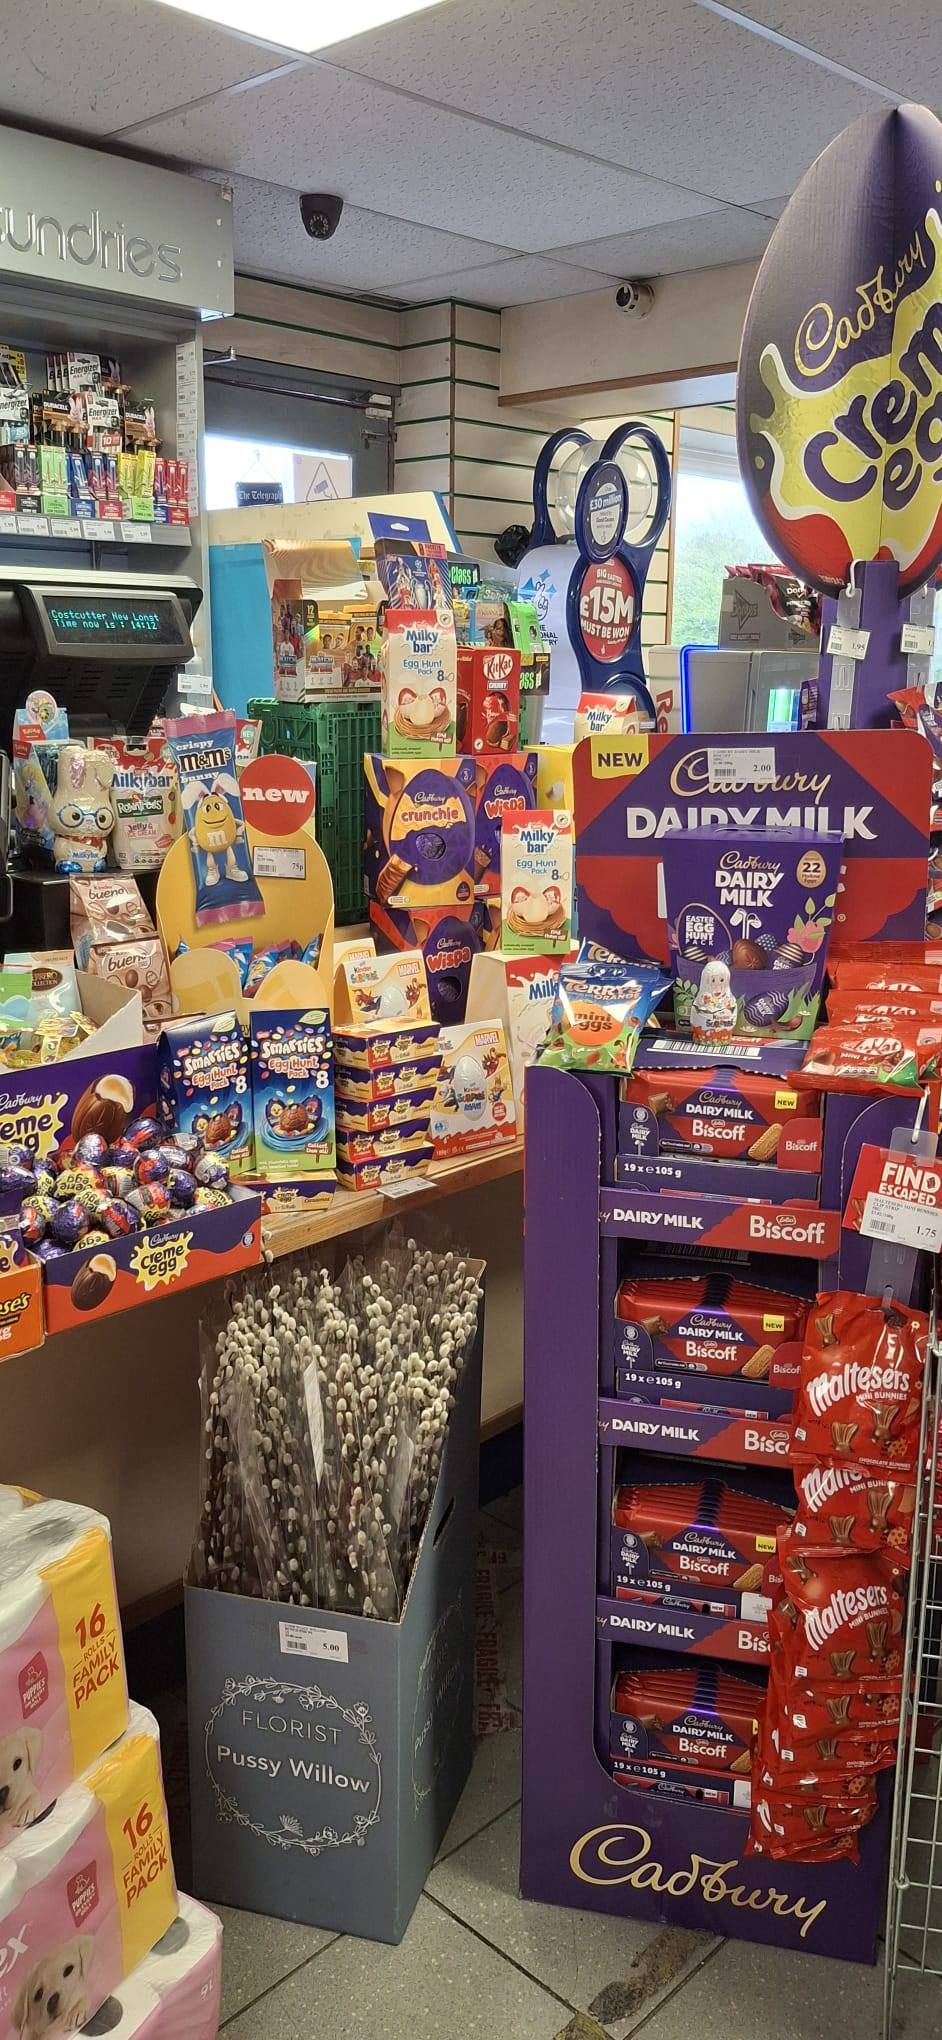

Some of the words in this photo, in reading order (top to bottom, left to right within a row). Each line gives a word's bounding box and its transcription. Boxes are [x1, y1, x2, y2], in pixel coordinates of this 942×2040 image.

[0, 207, 183, 283] undries
[794, 232, 927, 376] Cadbury
[70, 363, 100, 375] Energizer
[0, 399, 27, 410] nergizer
[803, 302, 942, 502] crem
[88, 408, 117, 418] Energizer
[597, 569, 607, 578] BIG
[580, 586, 633, 624] £15M
[51, 610, 107, 620] Costcutter
[54, 619, 78, 628] Time
[131, 621, 157, 630] 14:12
[581, 621, 600, 636] MUST
[601, 625, 611, 638] BE
[612, 626, 630, 639] WON
[405, 630, 439, 645] Milky
[413, 641, 433, 653] bar
[403, 660, 419, 669] Egg
[421, 660, 442, 669] Hunt
[485, 654, 513, 679] KitKat
[437, 670, 444, 682] 8
[587, 711, 612, 723] Milky
[590, 722, 605, 732] bar
[176, 739, 214, 752] crispy
[597, 752, 643, 768] NEW
[753, 764, 771, 772] 2.00
[181, 771, 220, 784] bunny
[243, 787, 310, 804] new
[415, 792, 445, 804] Cadbury
[494, 785, 517, 796] Cadbury
[401, 807, 459, 823] crunchie
[520, 830, 554, 843] Milky
[527, 841, 548, 853] bar
[292, 862, 304, 871] 75p
[517, 860, 532, 869] Egg
[536, 859, 557, 867] Hunt
[719, 850, 781, 874] Cadbury
[802, 862, 821, 873] 22
[551, 869, 559, 880] 8
[715, 871, 784, 890] DAIRY
[89, 886, 124, 900] bueno
[720, 888, 774, 908] MILK
[685, 915, 714, 924] EASTER
[685, 923, 715, 933] EGG
[685, 931, 715, 940] HUNT
[685, 938, 714, 946] PACK
[426, 948, 471, 972] Wispa
[397, 962, 421, 976] MARVEL
[529, 978, 558, 1000] Milk
[576, 1020, 612, 1031] ggs
[474, 1031, 499, 1046] MARVEL
[262, 1037, 324, 1059] SMARTIES
[184, 1043, 240, 1075] SMARTIES
[268, 1059, 288, 1072] Egg
[292, 1056, 319, 1070] Hunt
[192, 1075, 211, 1088] Egg
[212, 1063, 237, 1080] Hunt
[288, 1069, 308, 1078] Pack
[316, 1071, 329, 1088] 8
[210, 1080, 229, 1090] Pack
[235, 1075, 247, 1094] 8
[699, 1091, 742, 1108] Cadbury
[777, 1099, 794, 1107] NEW
[686, 1103, 723, 1117] DAIRY
[724, 1108, 754, 1121] MILK
[0, 1114, 53, 1140] eme
[630, 1128, 650, 1137] DAIRY
[692, 1119, 745, 1141] Biscoff
[785, 1140, 817, 1152] Biscoff
[624, 1163, 636, 1172] 19
[655, 1165, 673, 1175] 105
[675, 1169, 681, 1178] g
[881, 1162, 942, 1193] FIND
[878, 1183, 936, 1206] ESCAPED
[613, 1208, 662, 1225] DAIRY
[663, 1213, 704, 1230] MILK
[749, 1215, 825, 1245] Biscoff
[916, 1226, 937, 1238] 1.75
[150, 1232, 179, 1247] Cadbury
[140, 1243, 184, 1269] creme
[148, 1257, 177, 1276] egg
[690, 1313, 733, 1330] Cadbury
[765, 1321, 782, 1330] NEW
[678, 1326, 714, 1339] DAIRY
[714, 1330, 744, 1342] MILK
[621, 1343, 640, 1352] DAIRY
[622, 1349, 639, 1358] MILK
[686, 1340, 737, 1361] Biscoff
[773, 1363, 800, 1374] Biscof
[625, 1373, 637, 1383] 19
[655, 1375, 673, 1386] 105
[674, 1379, 681, 1389] g
[806, 1362, 910, 1416] Maltesers
[874, 1391, 907, 1401] BUNNIES
[612, 1418, 659, 1435] DAIRY
[661, 1423, 700, 1441] MILK
[744, 1430, 790, 1454] Bisc
[684, 1532, 725, 1548] Cadbury
[758, 1543, 774, 1551] NEW
[620, 1551, 640, 1560] DAIRY
[673, 1542, 708, 1554] DAIRY
[708, 1547, 737, 1559] MILK
[679, 1556, 730, 1576] Biscoff
[617, 1575, 629, 1583] 19
[646, 1580, 663, 1590] 105
[665, 1584, 671, 1592] g
[804, 1584, 888, 1650] Maltesers
[75, 1603, 107, 1650] 16
[610, 1615, 656, 1632] DAIRY
[657, 1621, 696, 1640] MILK
[84, 1636, 105, 1661] ROLLS
[323, 1643, 340, 1651] 5.00
[73, 1637, 117, 1688] FAMILY
[74, 1653, 120, 1710] PACK
[242, 1710, 343, 1744] FLORIST
[684, 1716, 723, 1731] Cadbury
[672, 1725, 705, 1737] DAIRY
[707, 1730, 734, 1742] MILK
[679, 1737, 727, 1758] Biscoff
[217, 1745, 281, 1777] Pussy
[289, 1758, 371, 1793] Willow
[614, 1761, 625, 1769] 19
[642, 1766, 658, 1776] 105
[660, 1770, 666, 1778] g
[123, 1803, 154, 1850] 16
[134, 1834, 154, 1860] ROLLS
[122, 1832, 164, 1890] FAMILY
[126, 1847, 168, 1909] PACK
[570, 1824, 827, 1938] Cadbury
